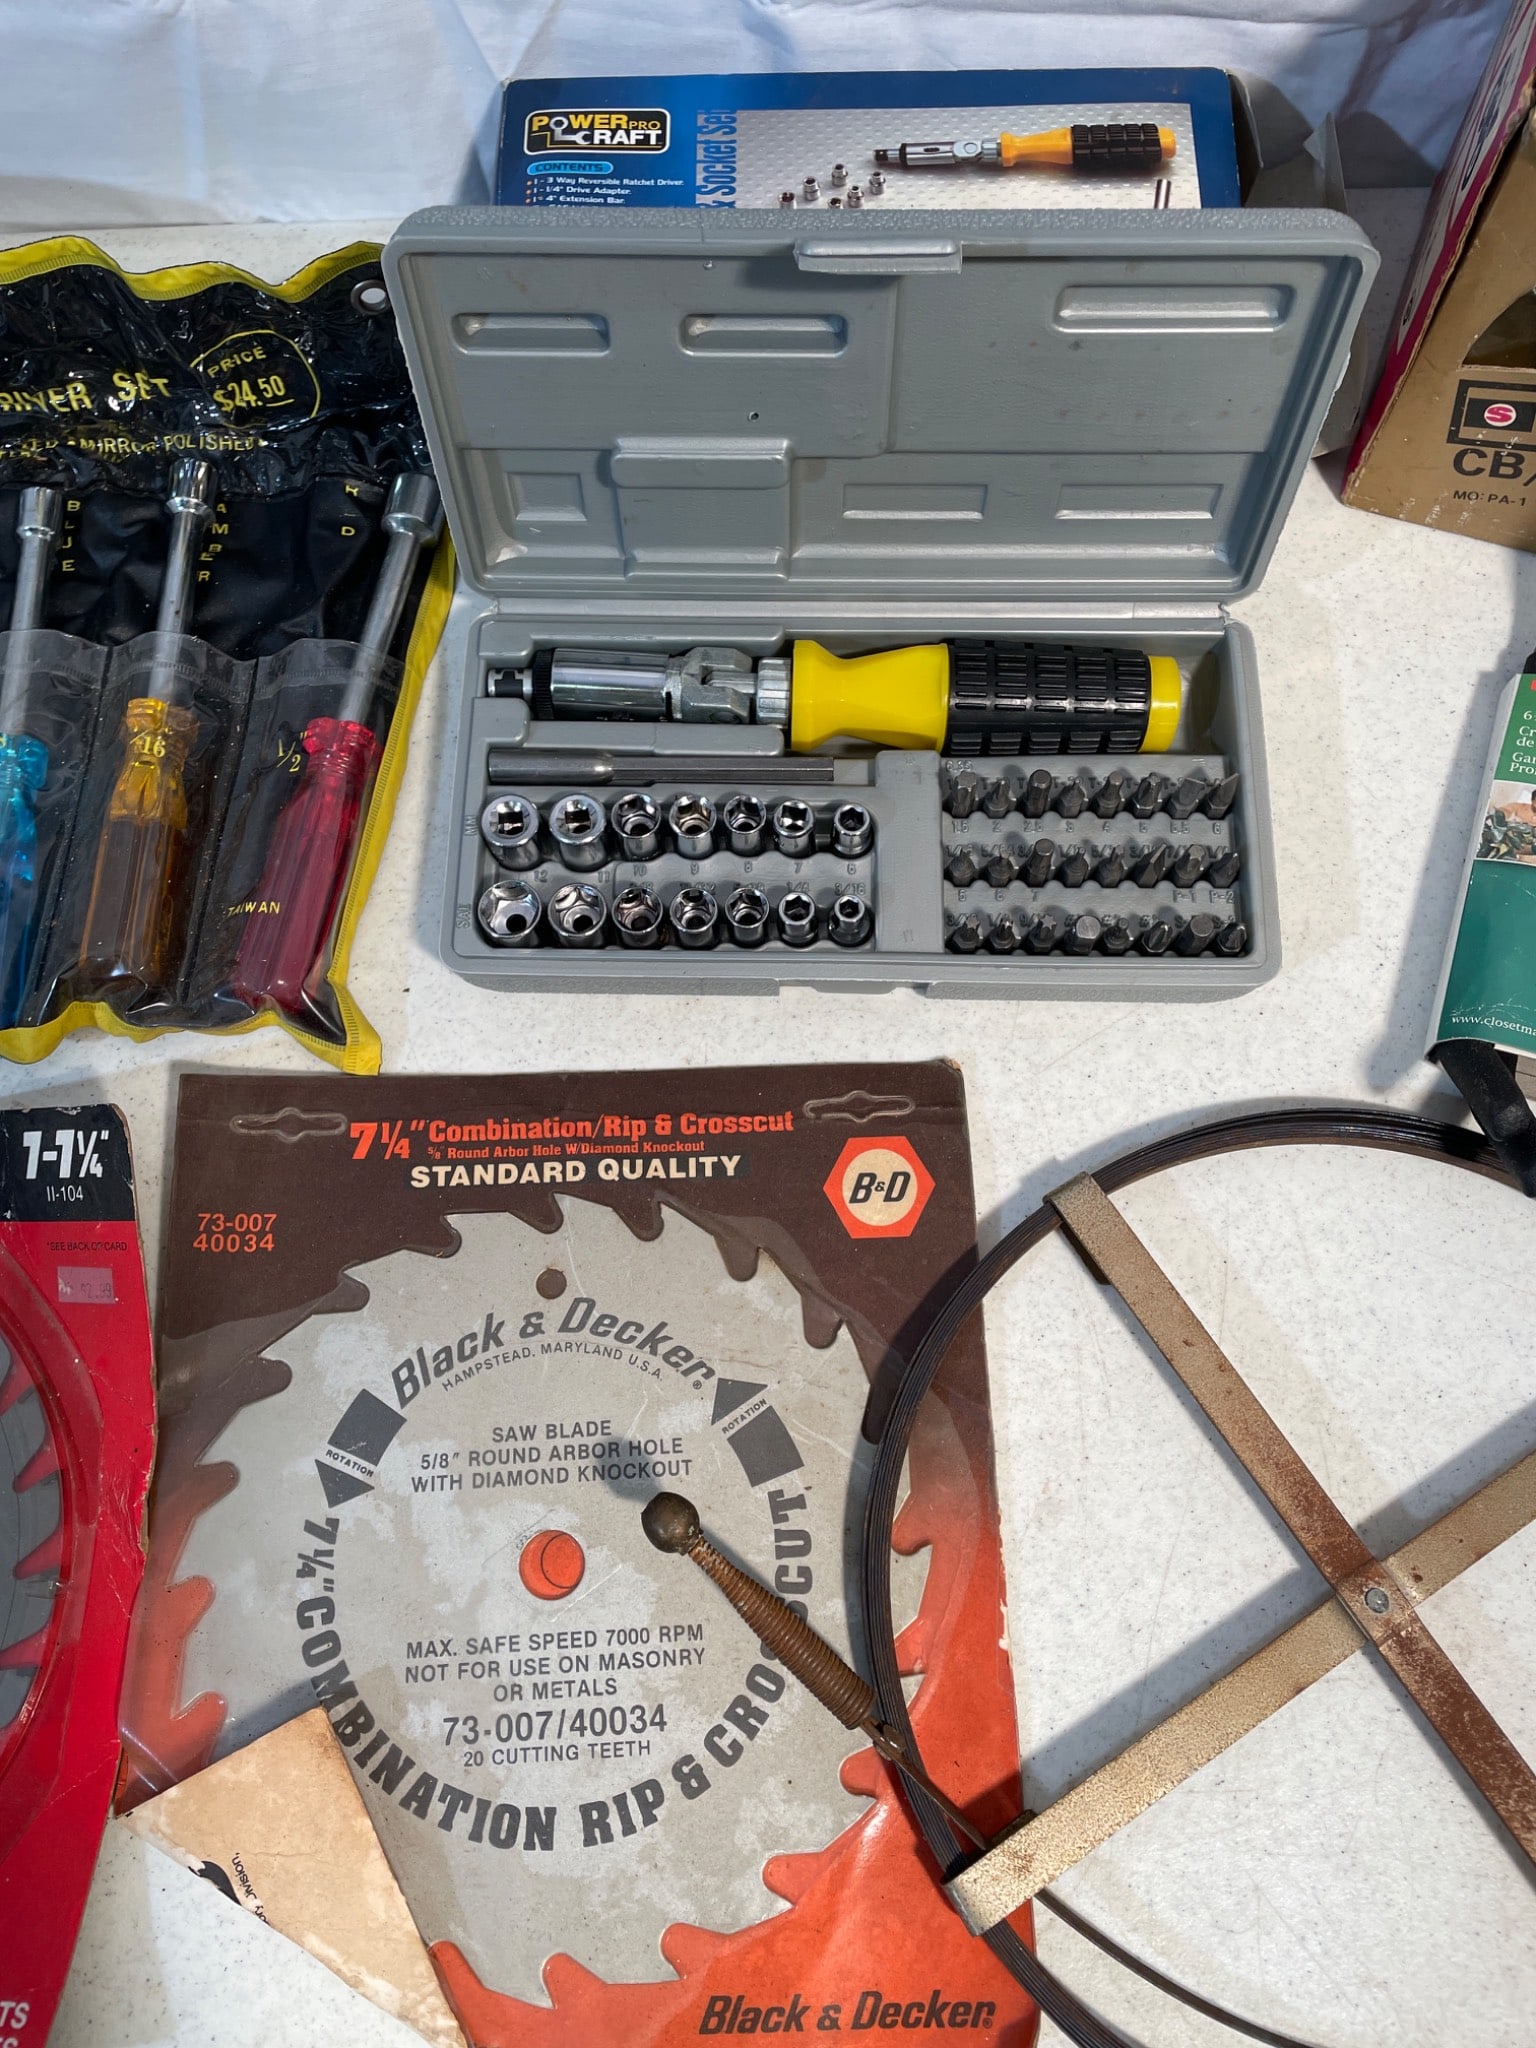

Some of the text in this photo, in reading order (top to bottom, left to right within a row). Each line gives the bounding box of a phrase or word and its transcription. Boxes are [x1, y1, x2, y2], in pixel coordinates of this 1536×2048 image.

[532, 114, 661, 131] POWER PRO
[575, 130, 662, 145] CRAFT
[535, 163, 604, 172] CONTENTS
[697, 139, 737, 196] Socket
[556, 178, 576, 187] Way
[578, 178, 620, 186] Reversible
[623, 178, 655, 186] Ratchet
[657, 179, 684, 187] Driver.
[593, 187, 632, 196] Adapter.
[560, 195, 605, 204] Extension
[207, 346, 267, 379] PRICE
[213, 374, 286, 413] $24.50
[1488, 493, 1526, 507] PA-1
[1516, 737, 1534, 748] de
[1509, 762, 1536, 776] Pro
[834, 882, 866, 895] 3/16
[226, 901, 281, 916] TAIWAN
[428, 1113, 646, 1143] Combination/Rip
[655, 1115, 673, 1136] &
[679, 1110, 795, 1136] Crosscut
[447, 1146, 489, 1160] Round
[494, 1145, 529, 1158] Arbor
[532, 1143, 562, 1157] Hole
[566, 1139, 639, 1155] W/Diamond
[643, 1138, 705, 1153] Knockout
[410, 1154, 742, 1188] STANDARD QUALITY
[848, 1170, 911, 1205] B&D
[197, 1212, 278, 1233] 73-007
[104, 1241, 128, 1252] CARD
[193, 1232, 276, 1253] 40034
[392, 1311, 506, 1409] Black
[518, 1309, 545, 1339] &
[540, 1341, 622, 1362] MARYLAND
[720, 1397, 768, 1435] ROTATION
[491, 1419, 613, 1444] SAW BLADE
[324, 1448, 375, 1479] ROTATION
[467, 1446, 545, 1468] ROUND
[549, 1441, 621, 1463] ARBOR
[628, 1437, 684, 1458] HOLE
[410, 1459, 693, 1493] WITH DIAMOND KNOCKOUT
[405, 1623, 704, 1660] MAX. SAFE SPEED 7000 RPM
[295, 1594, 557, 1852] COMBINATION
[579, 1777, 666, 1848] RIP
[671, 1753, 713, 1801] &
[703, 1487, 815, 1768] CROCUT
[404, 1646, 707, 1684] NOT FOR USE ON MASONRY
[492, 1676, 619, 1703] OR METALS
[442, 1703, 669, 1747] 73-007/40034
[463, 1739, 652, 1768] 20 CUTTING TEETH
[698, 1993, 809, 2035] Black
[816, 2003, 842, 2031] &
